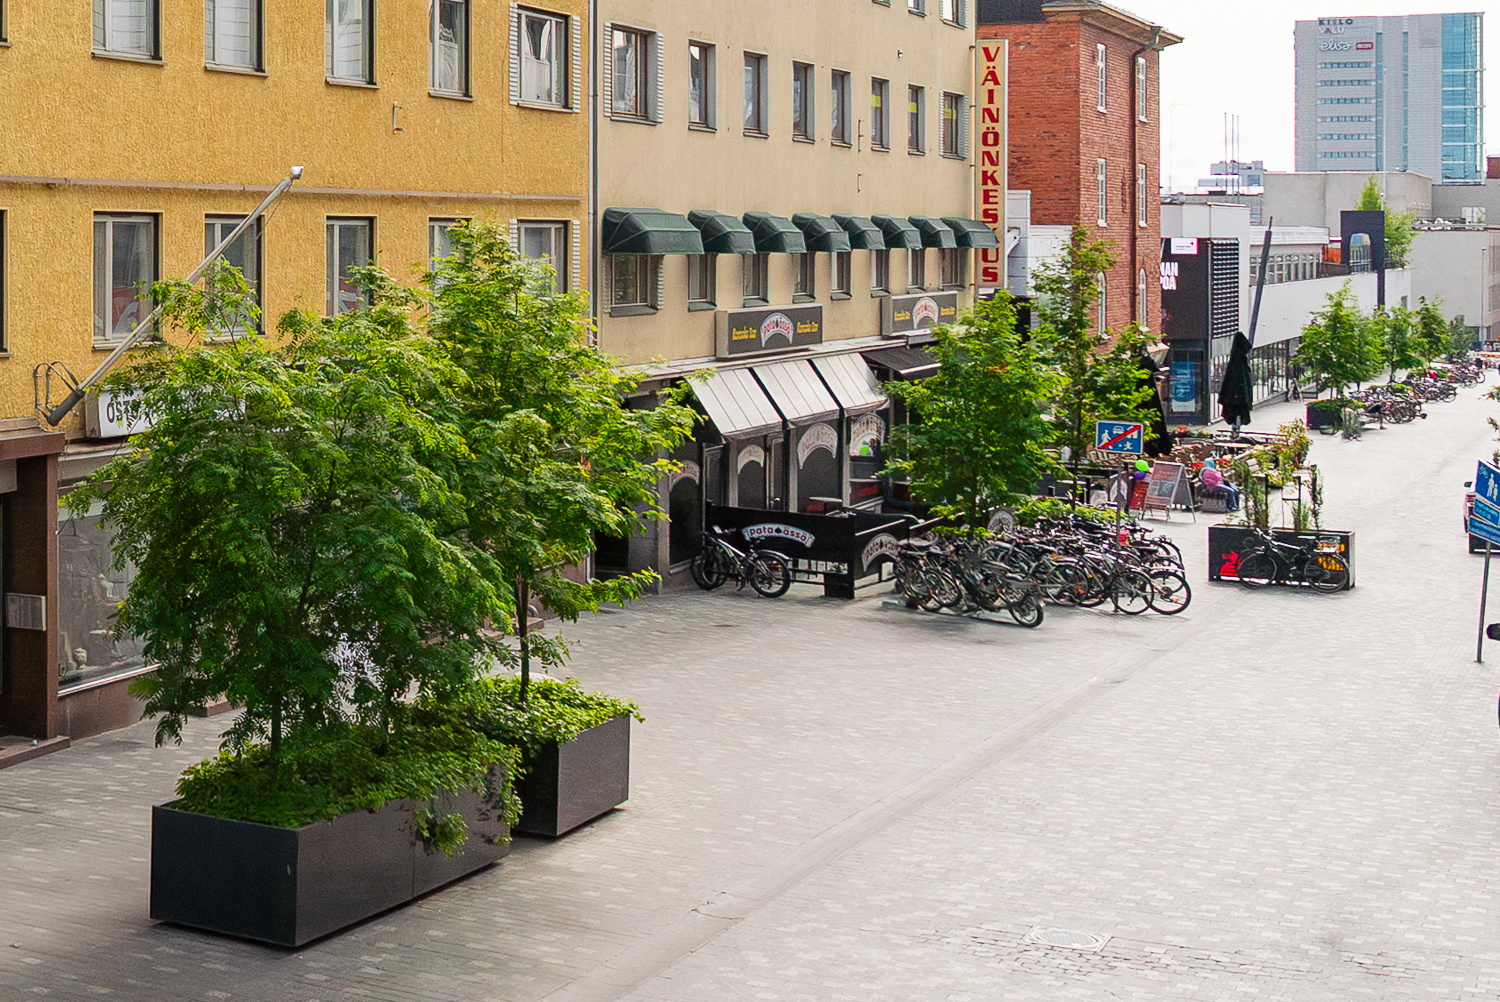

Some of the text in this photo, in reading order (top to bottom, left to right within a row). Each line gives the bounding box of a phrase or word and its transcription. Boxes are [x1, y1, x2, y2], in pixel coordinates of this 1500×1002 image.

[1319, 39, 1352, 51] elisa
[981, 46, 1001, 283] VÄINÖNKESUS
[749, 525, 808, 543] pata ässä
